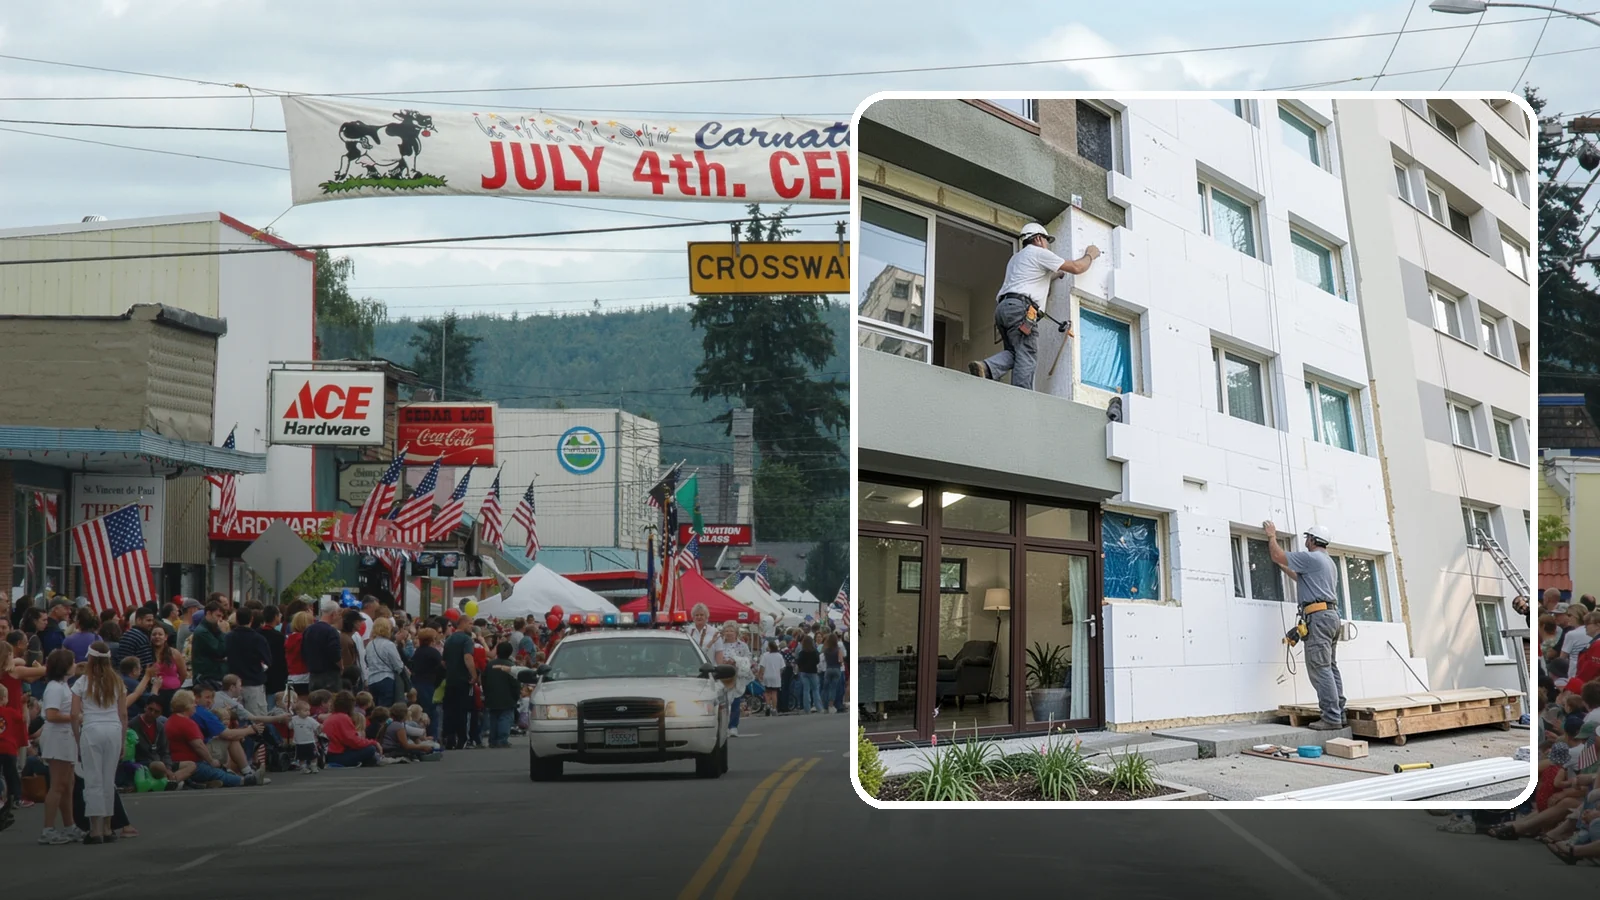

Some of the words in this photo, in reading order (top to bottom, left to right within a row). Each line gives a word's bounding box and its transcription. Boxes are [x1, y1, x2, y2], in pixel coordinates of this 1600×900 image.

[694, 121, 850, 149] Carnat
[481, 141, 605, 192] JULY
[632, 150, 746, 198] 4th.
[696, 254, 850, 280] CROSSWA
[283, 380, 373, 420] ACE
[405, 409, 452, 422] CEDAR
[283, 421, 371, 437] Hardware
[83, 485, 93, 495] St.
[95, 485, 124, 495] Vincent
[126, 486, 136, 495] de
[138, 486, 155, 496] Paul
[688, 526, 742, 535] CRNATION
[699, 535, 731, 543] GLASS
